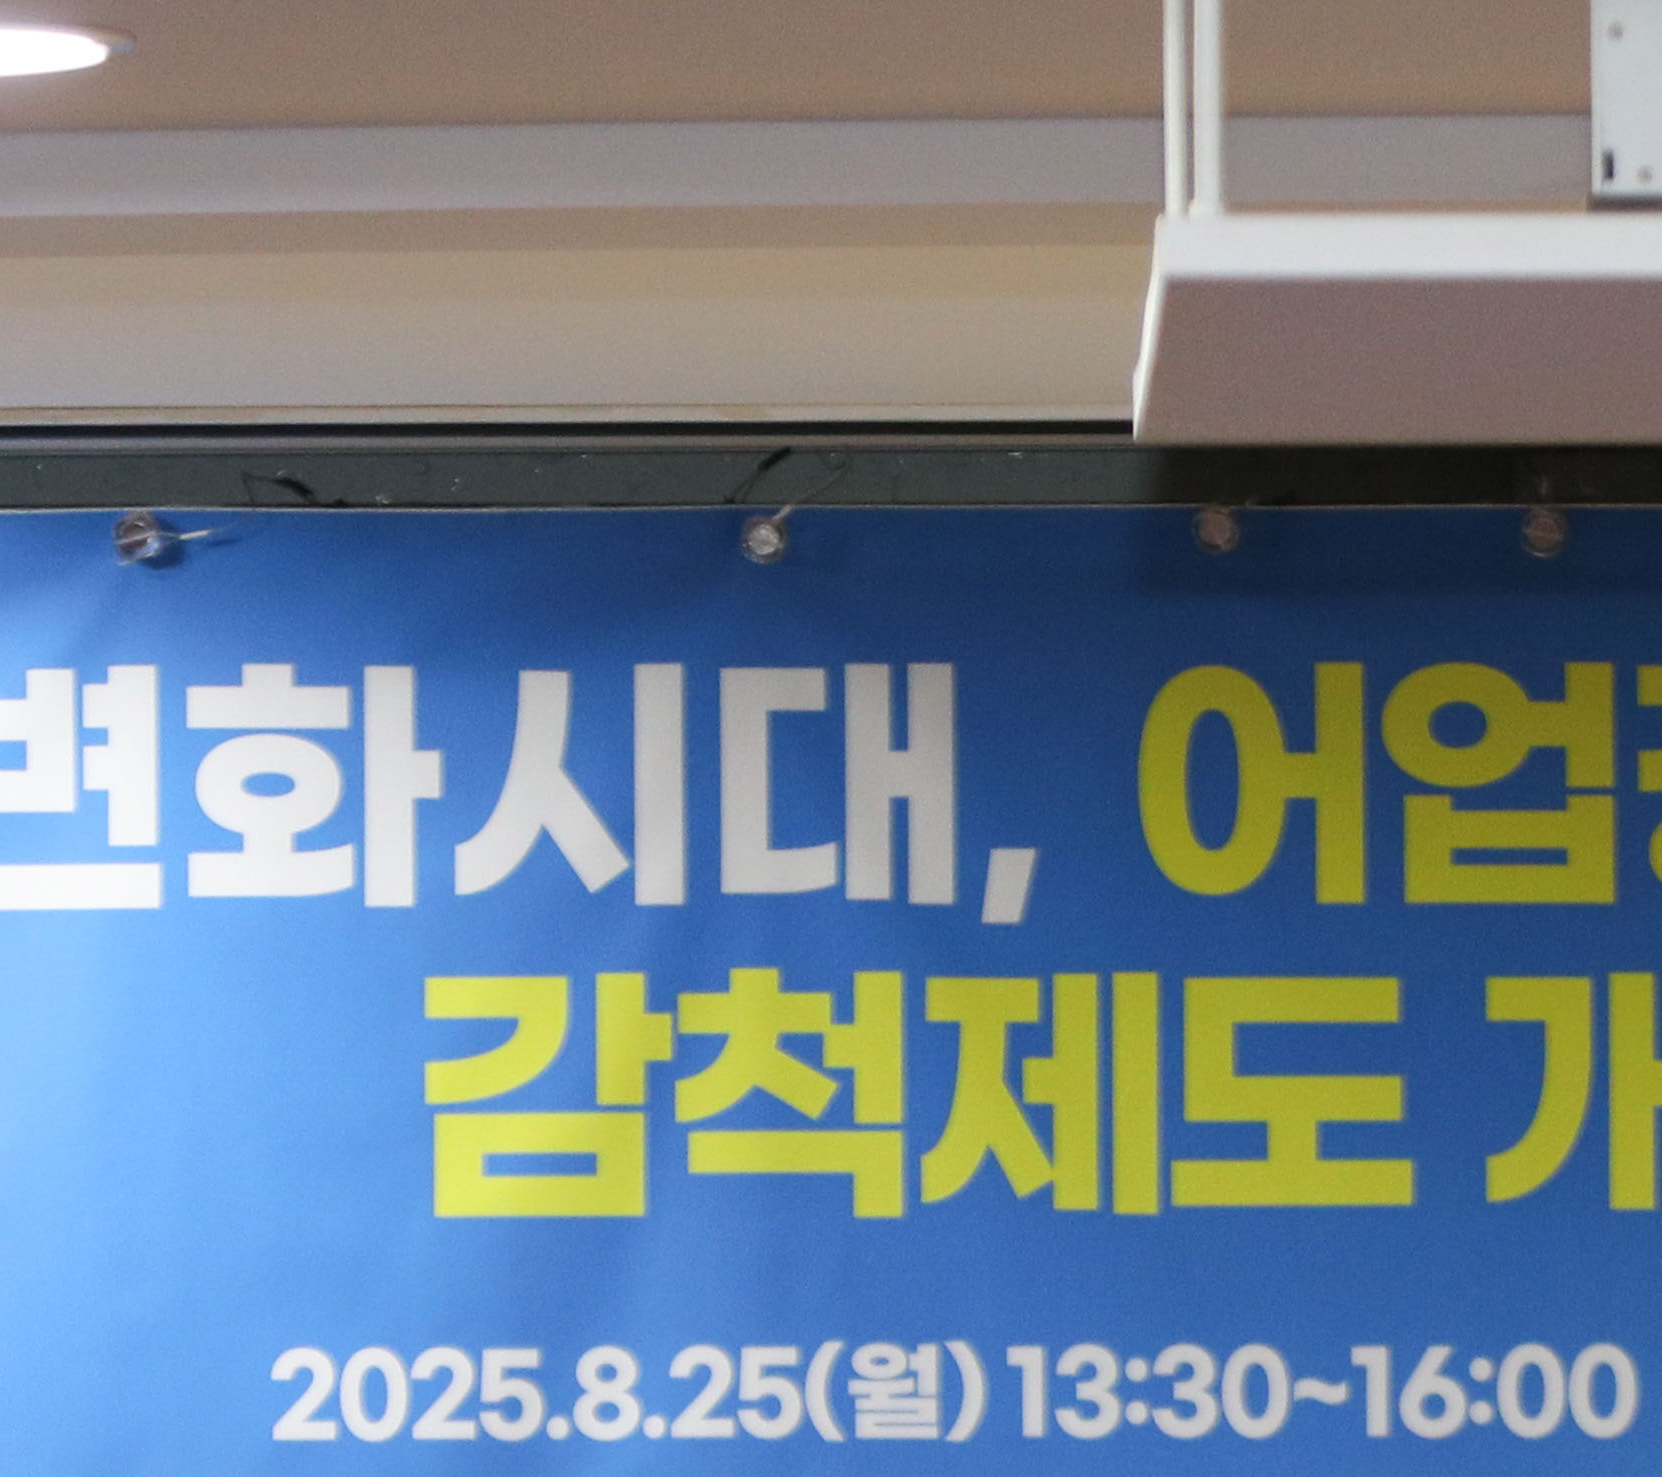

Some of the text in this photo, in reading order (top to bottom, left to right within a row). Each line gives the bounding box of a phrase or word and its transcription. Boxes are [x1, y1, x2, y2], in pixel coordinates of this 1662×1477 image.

[422, 966, 1416, 1219] 감척제도
[269, 1339, 987, 1443] 2025.8.25(월)
[1005, 1341, 1640, 1441] 13:30~16:00
